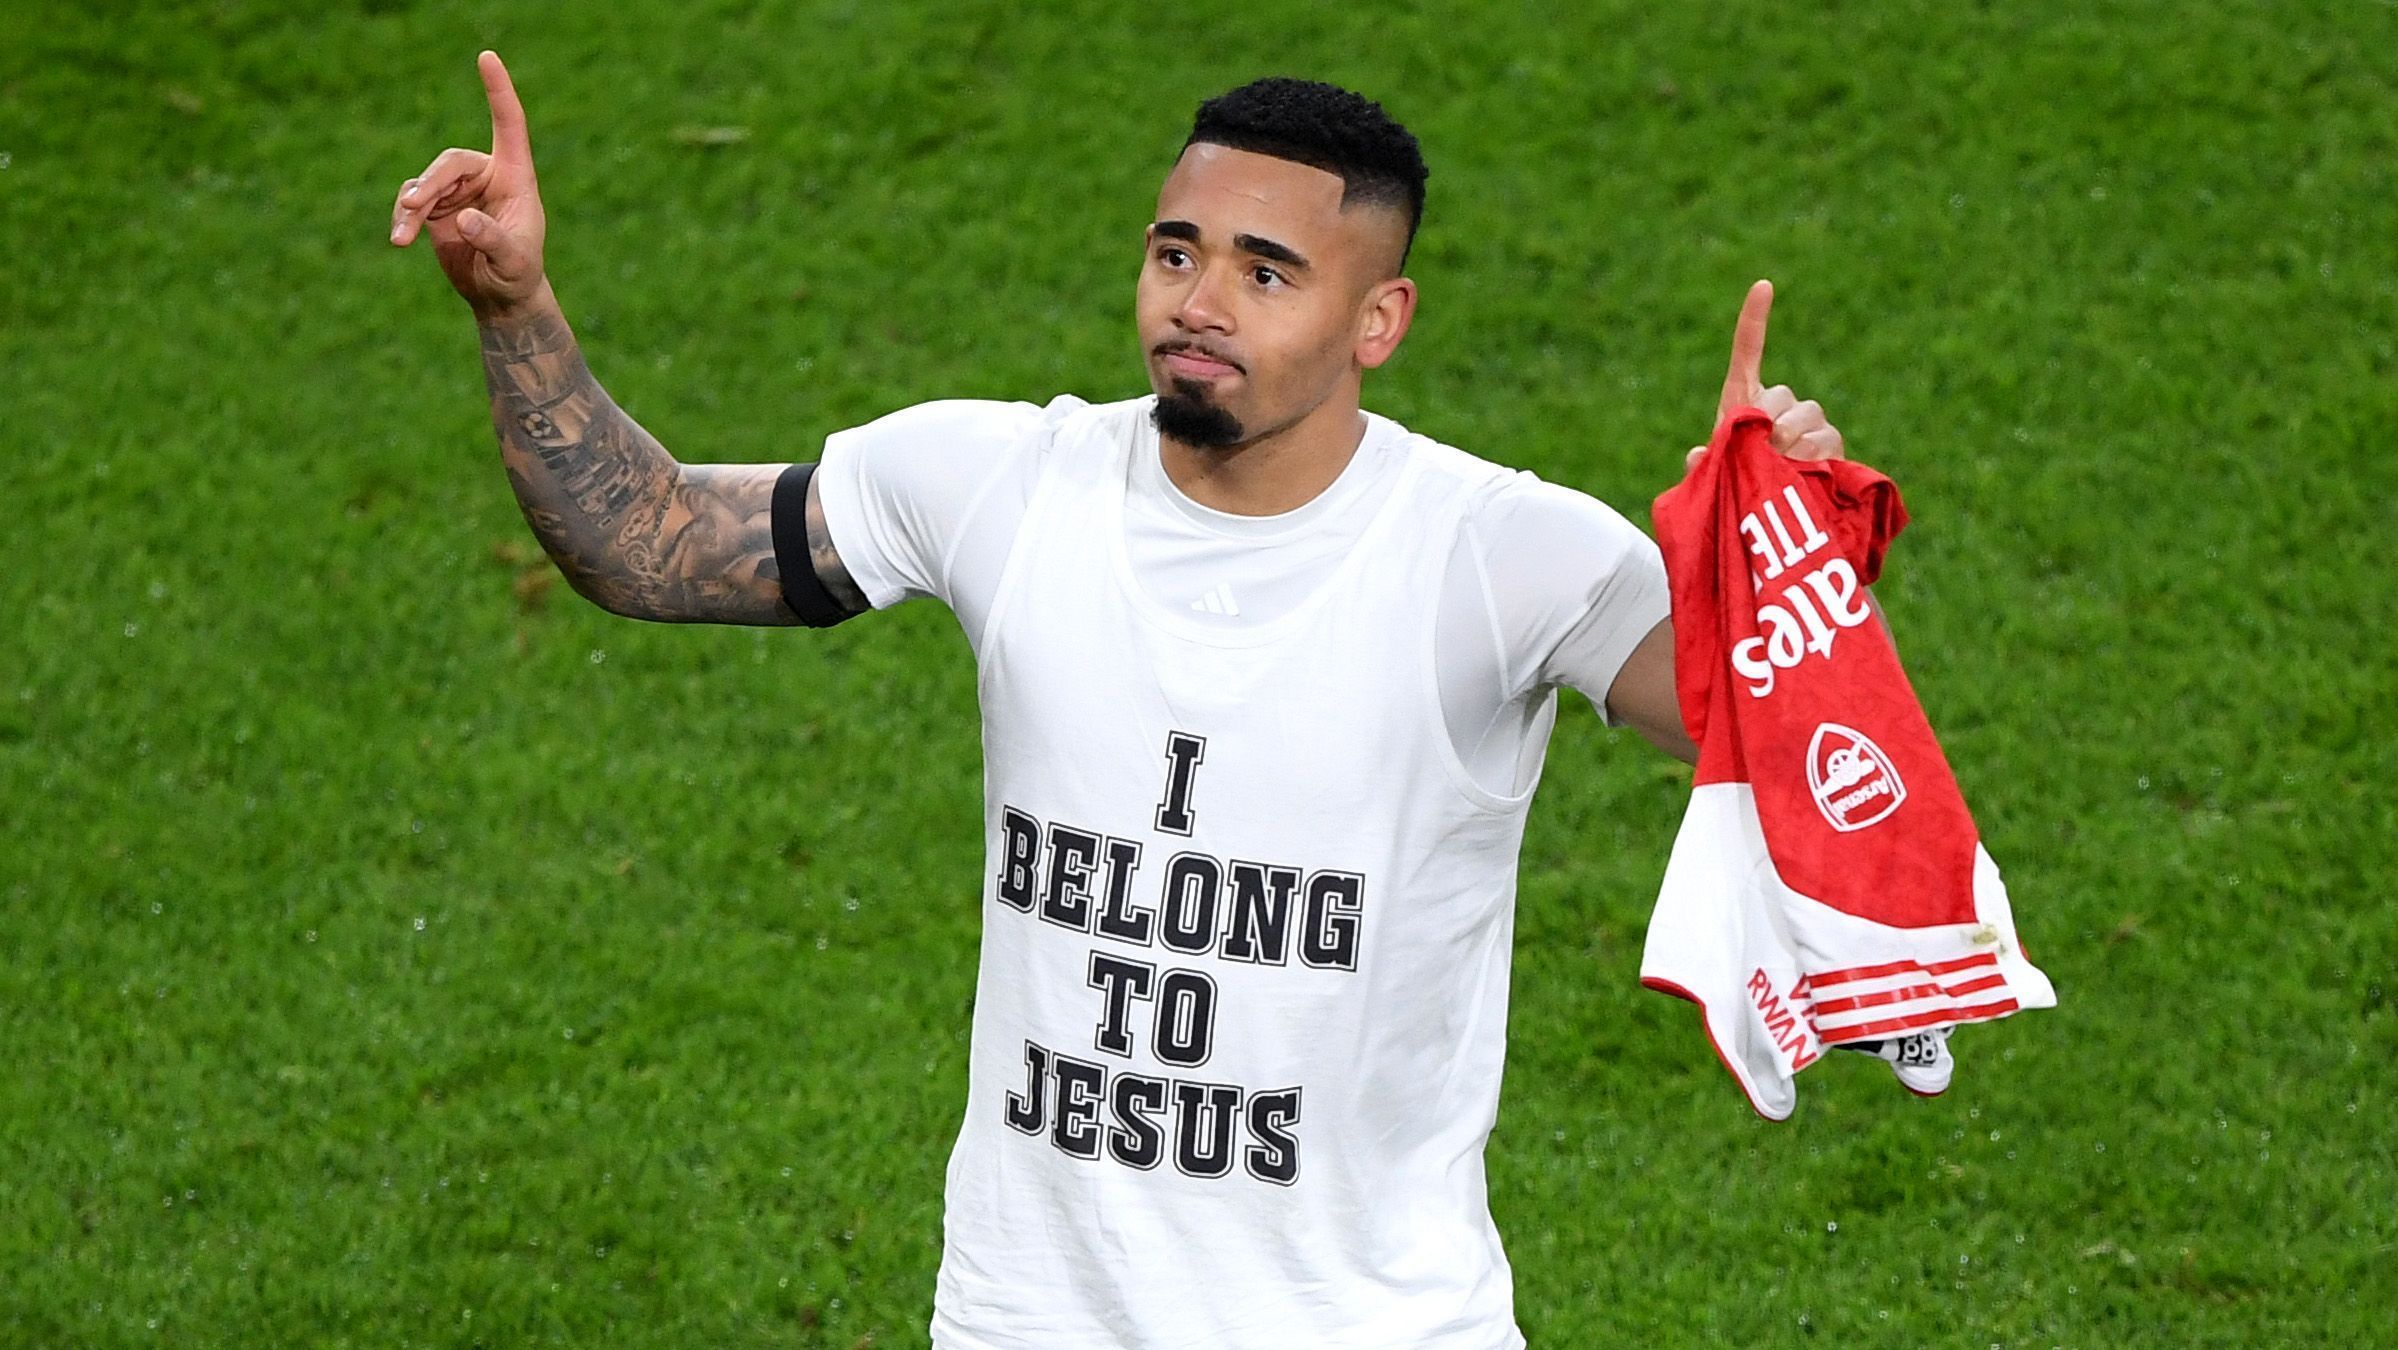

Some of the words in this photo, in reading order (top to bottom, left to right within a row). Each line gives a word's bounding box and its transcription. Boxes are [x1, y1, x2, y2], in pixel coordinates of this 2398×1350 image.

[1740, 485, 1829, 596] TTE
[1732, 558, 1870, 697] ates
[1154, 730, 1206, 837] I
[1831, 775, 1890, 820] Arsenal
[996, 805, 1365, 972] BELONG
[1087, 950, 1218, 1068] TO
[1747, 967, 1818, 1071] RWAN
[1004, 1039, 1302, 1186] JESUS
